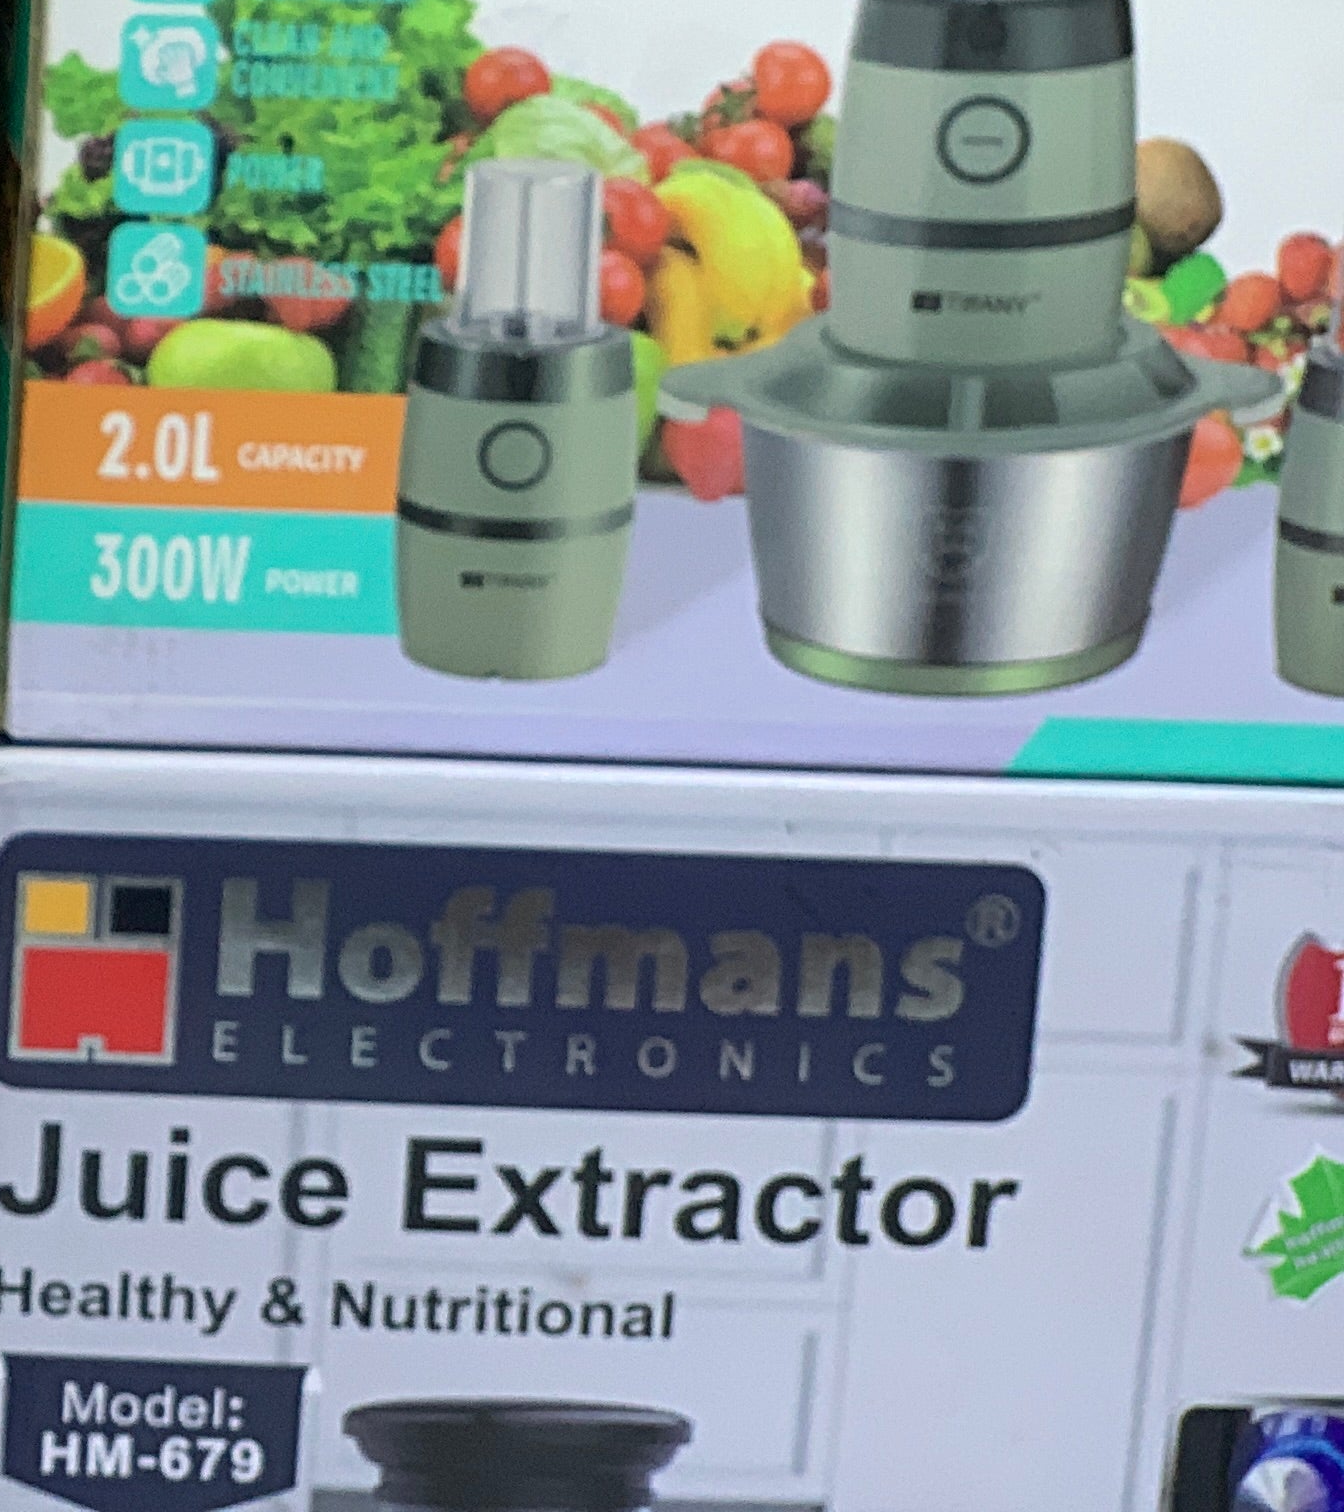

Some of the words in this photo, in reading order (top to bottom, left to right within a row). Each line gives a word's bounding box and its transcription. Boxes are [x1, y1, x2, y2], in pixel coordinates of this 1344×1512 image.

[220, 257, 357, 299] STAINLESS
[366, 261, 444, 303] STEEL
[98, 408, 220, 482] 2.0L
[237, 441, 367, 474] CAPACITY
[90, 533, 253, 604] 300W
[265, 568, 360, 600] POWER
[213, 873, 967, 1022] Hoffmans
[212, 1020, 958, 1087] ELECTRONICS
[401, 1134, 1021, 1250] Extractor
[261, 1277, 305, 1328] &
[330, 1281, 677, 1342] Nutritional
[61, 1379, 247, 1434] Model:
[39, 1431, 265, 1484] HM-679
